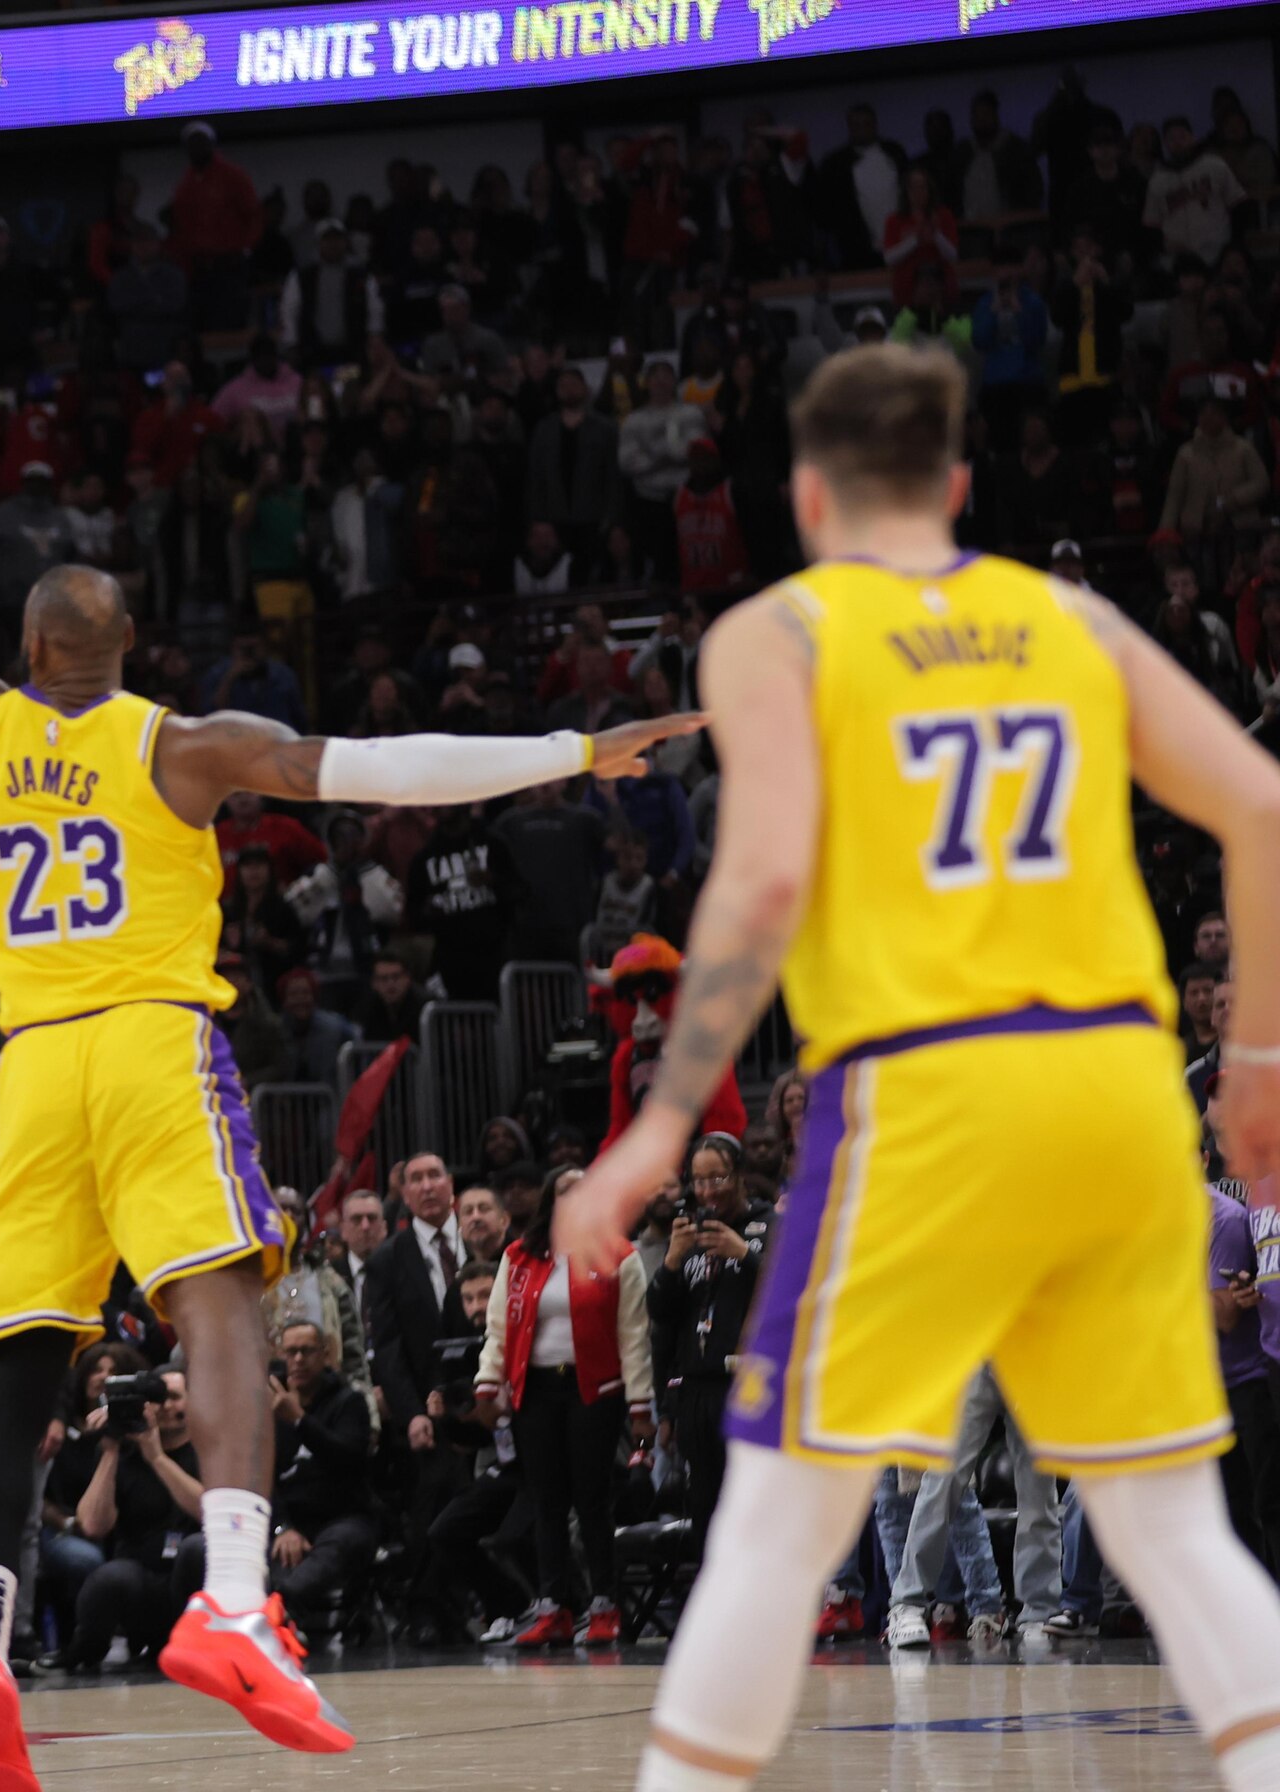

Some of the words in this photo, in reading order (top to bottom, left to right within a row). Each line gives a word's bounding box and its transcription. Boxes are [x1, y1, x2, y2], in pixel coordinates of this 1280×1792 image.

[236, 22, 380, 87] IGNITE
[389, 10, 503, 73] YOUR
[512, 0, 719, 62] INTENSITY
[6, 756, 100, 806] JAMES
[890, 704, 1082, 893] 77
